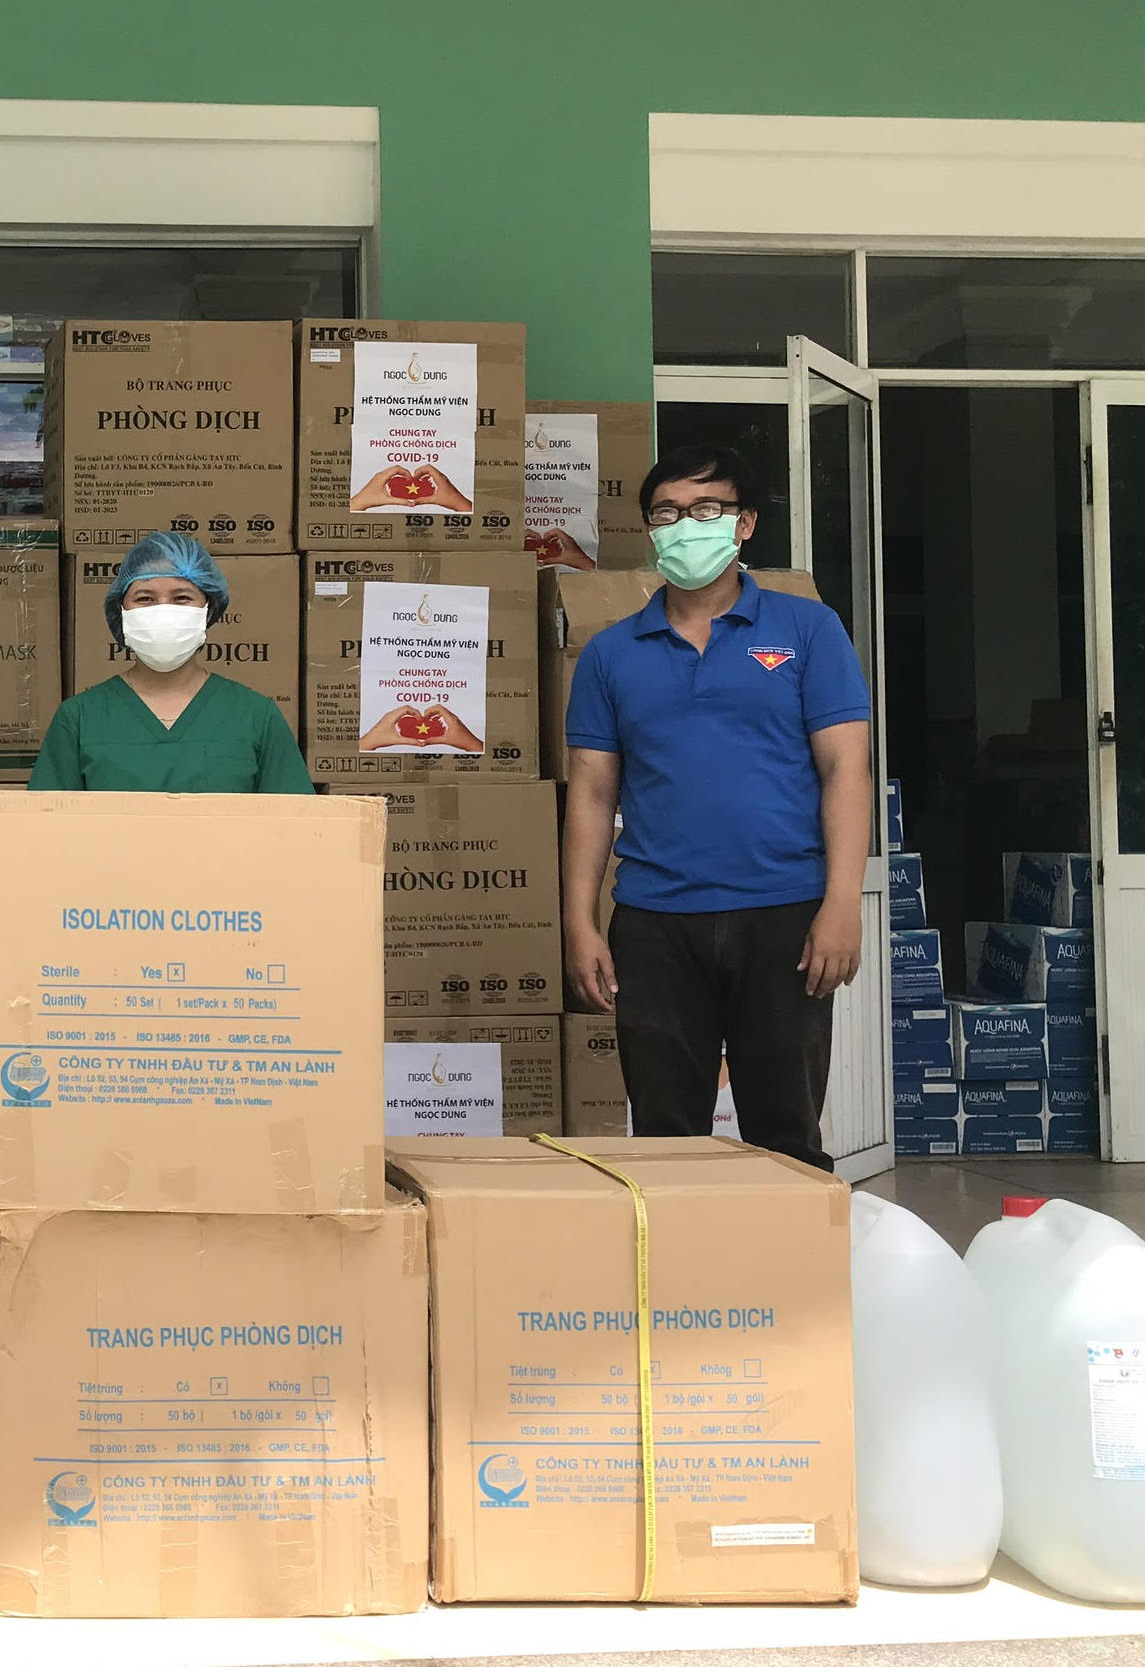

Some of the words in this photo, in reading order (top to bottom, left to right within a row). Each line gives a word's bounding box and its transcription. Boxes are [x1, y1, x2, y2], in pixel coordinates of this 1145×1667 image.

[73, 331, 113, 345] HTC
[310, 327, 352, 340] HTC
[424, 372, 447, 380] DUNG
[126, 378, 144, 393] BỘ
[147, 381, 193, 391] TRANG
[196, 381, 232, 392] PHỤC
[434, 396, 448, 405] MỸ
[389, 409, 415, 417] NGỌC
[97, 405, 187, 430] PHÒNG
[195, 411, 261, 433] DỊCH
[370, 439, 401, 447] PHÒNG
[403, 438, 433, 448] CHỐNG
[436, 441, 456, 449] DỊCH
[387, 453, 439, 462] COVID-19
[525, 474, 542, 482] GỌC
[563, 507, 581, 515] DỊCH
[170, 520, 198, 531] ISO
[208, 520, 236, 531] ISO
[247, 520, 274, 531] ISO
[405, 516, 434, 527] ISO
[443, 516, 471, 528] ISO
[482, 517, 510, 528] ISO
[525, 518, 565, 526] OVID-19
[315, 561, 357, 574] HTC
[434, 614, 458, 623] DUNG
[443, 639, 457, 648] MỸ
[207, 643, 270, 665] DỊCH
[397, 650, 422, 659] NGỌC
[379, 678, 410, 687] PHÒNG
[413, 678, 443, 688] CHỐNG
[446, 681, 467, 690] DỊCH
[397, 693, 449, 702] COVID-19
[492, 748, 521, 759] ISO
[393, 839, 410, 854] BỘ
[414, 842, 459, 851] TRANG
[463, 840, 498, 852] PHỤC
[384, 866, 454, 891] HÒNG
[463, 869, 527, 892] DỊCH
[62, 909, 165, 930] ISOLATION
[171, 910, 263, 932] CLOTHES
[42, 966, 80, 977] Sterile
[141, 967, 162, 978] Yes
[246, 968, 263, 980] No
[442, 981, 469, 992] ISO
[480, 980, 508, 991] ISO
[519, 979, 546, 989] ISO
[42, 993, 87, 1008] Quantity
[126, 997, 137, 1006] 50
[140, 998, 153, 1007] Set
[234, 999, 244, 1008] 50
[249, 999, 277, 1010] Packs)
[974, 1019, 1031, 1035] AQUAFINA
[47, 1031, 63, 1040] ISO
[65, 1032, 86, 1040] 9001
[95, 1032, 116, 1041] 2015
[137, 1032, 153, 1041] ISO
[228, 1034, 251, 1045] GMP,
[272, 1035, 291, 1044] FDA
[59, 1055, 102, 1069] CÔNG
[107, 1058, 123, 1069] TY
[129, 1059, 167, 1070] TNHH
[207, 1059, 228, 1071] TƯ
[232, 1060, 242, 1072] &
[246, 1061, 267, 1072] TM
[270, 1061, 291, 1072] AN
[296, 1058, 335, 1073] LÀNH
[448, 1073, 471, 1081] DUNG
[459, 1098, 472, 1106] MỸ
[965, 1090, 1007, 1103] AQUAFINA
[415, 1112, 440, 1120] NGỌC
[518, 1312, 587, 1332] TRANG
[653, 1306, 722, 1329] PHÒNG
[728, 1308, 774, 1333] DỊCH
[86, 1328, 154, 1348] TRANG
[160, 1327, 214, 1351] PHỤC
[221, 1322, 291, 1345] PHÒNG
[297, 1325, 343, 1349] DỊCH
[610, 1365, 623, 1377] Có
[700, 1363, 732, 1376] Không
[176, 1381, 190, 1393] Có
[268, 1381, 301, 1393] Không
